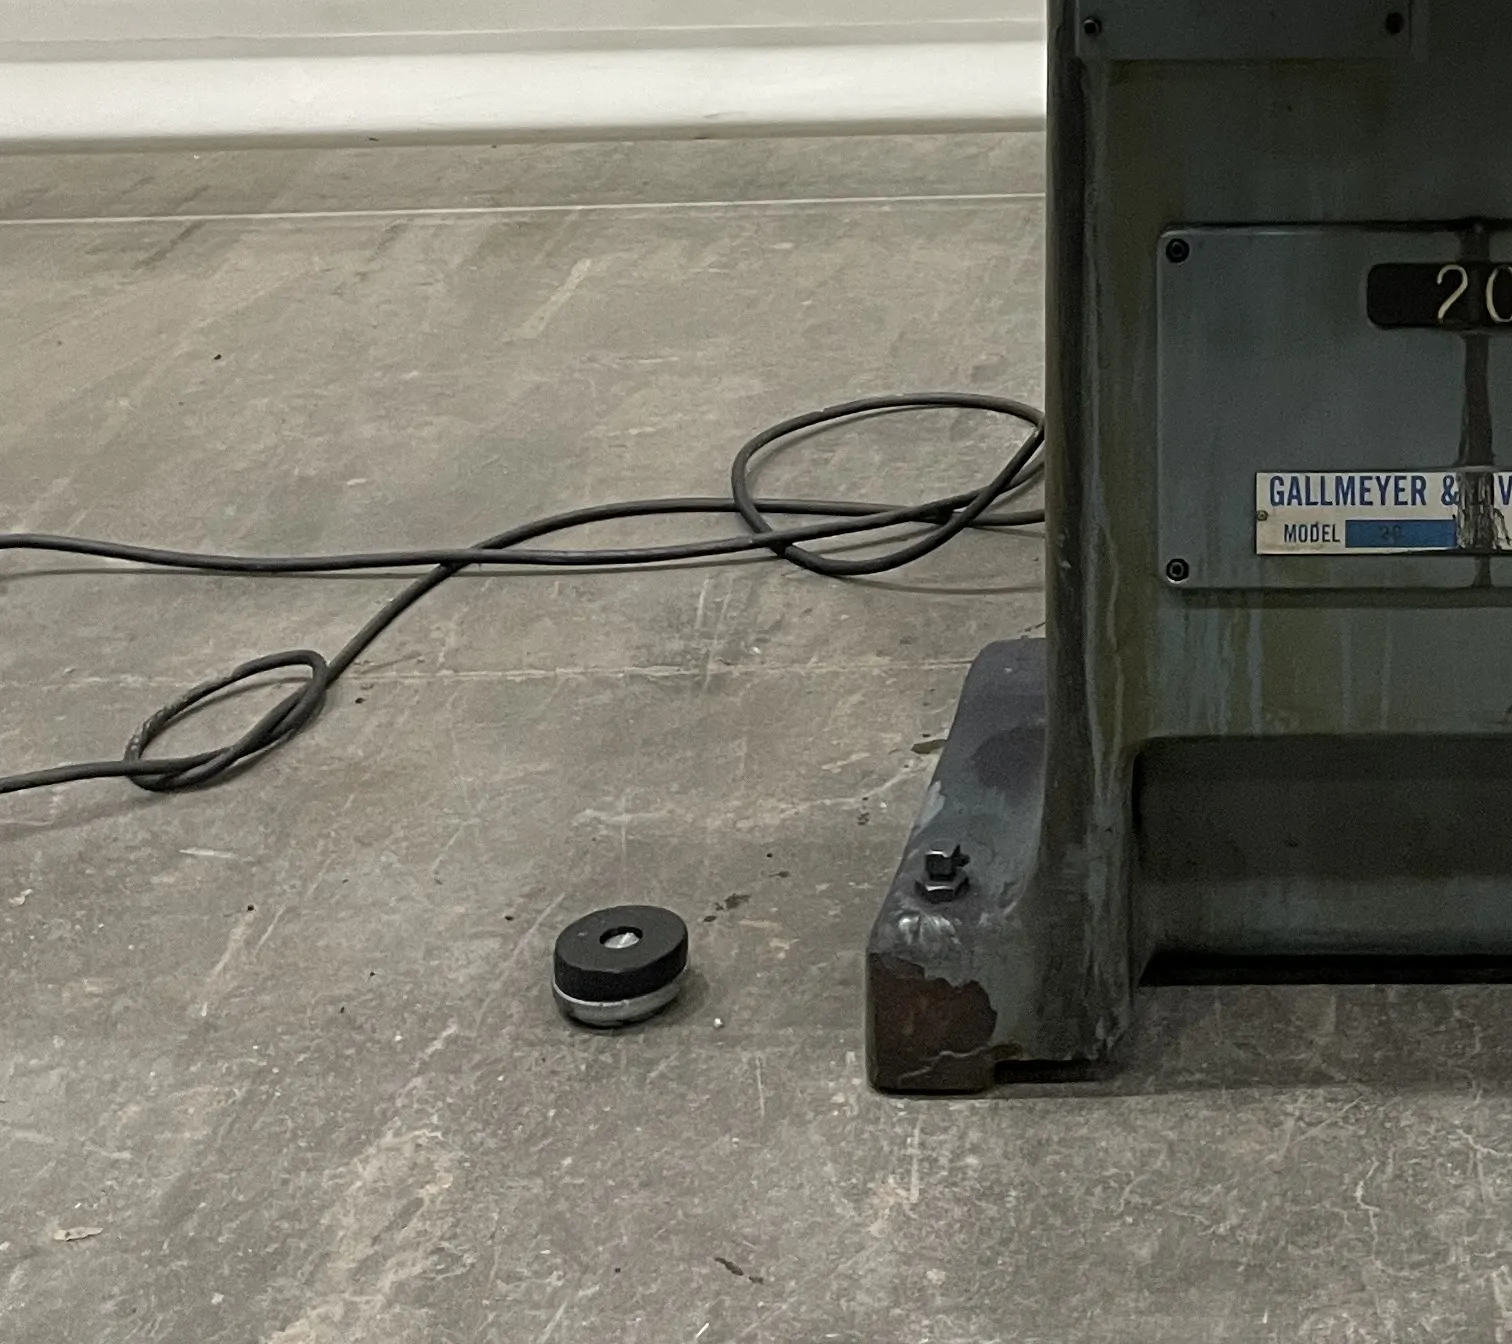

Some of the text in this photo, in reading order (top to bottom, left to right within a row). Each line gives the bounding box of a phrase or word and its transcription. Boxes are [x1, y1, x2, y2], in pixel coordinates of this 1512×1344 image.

[1270, 474, 1428, 507] GALLMEYER
[1440, 474, 1460, 506] &
[1283, 523, 1341, 543] MODEL
